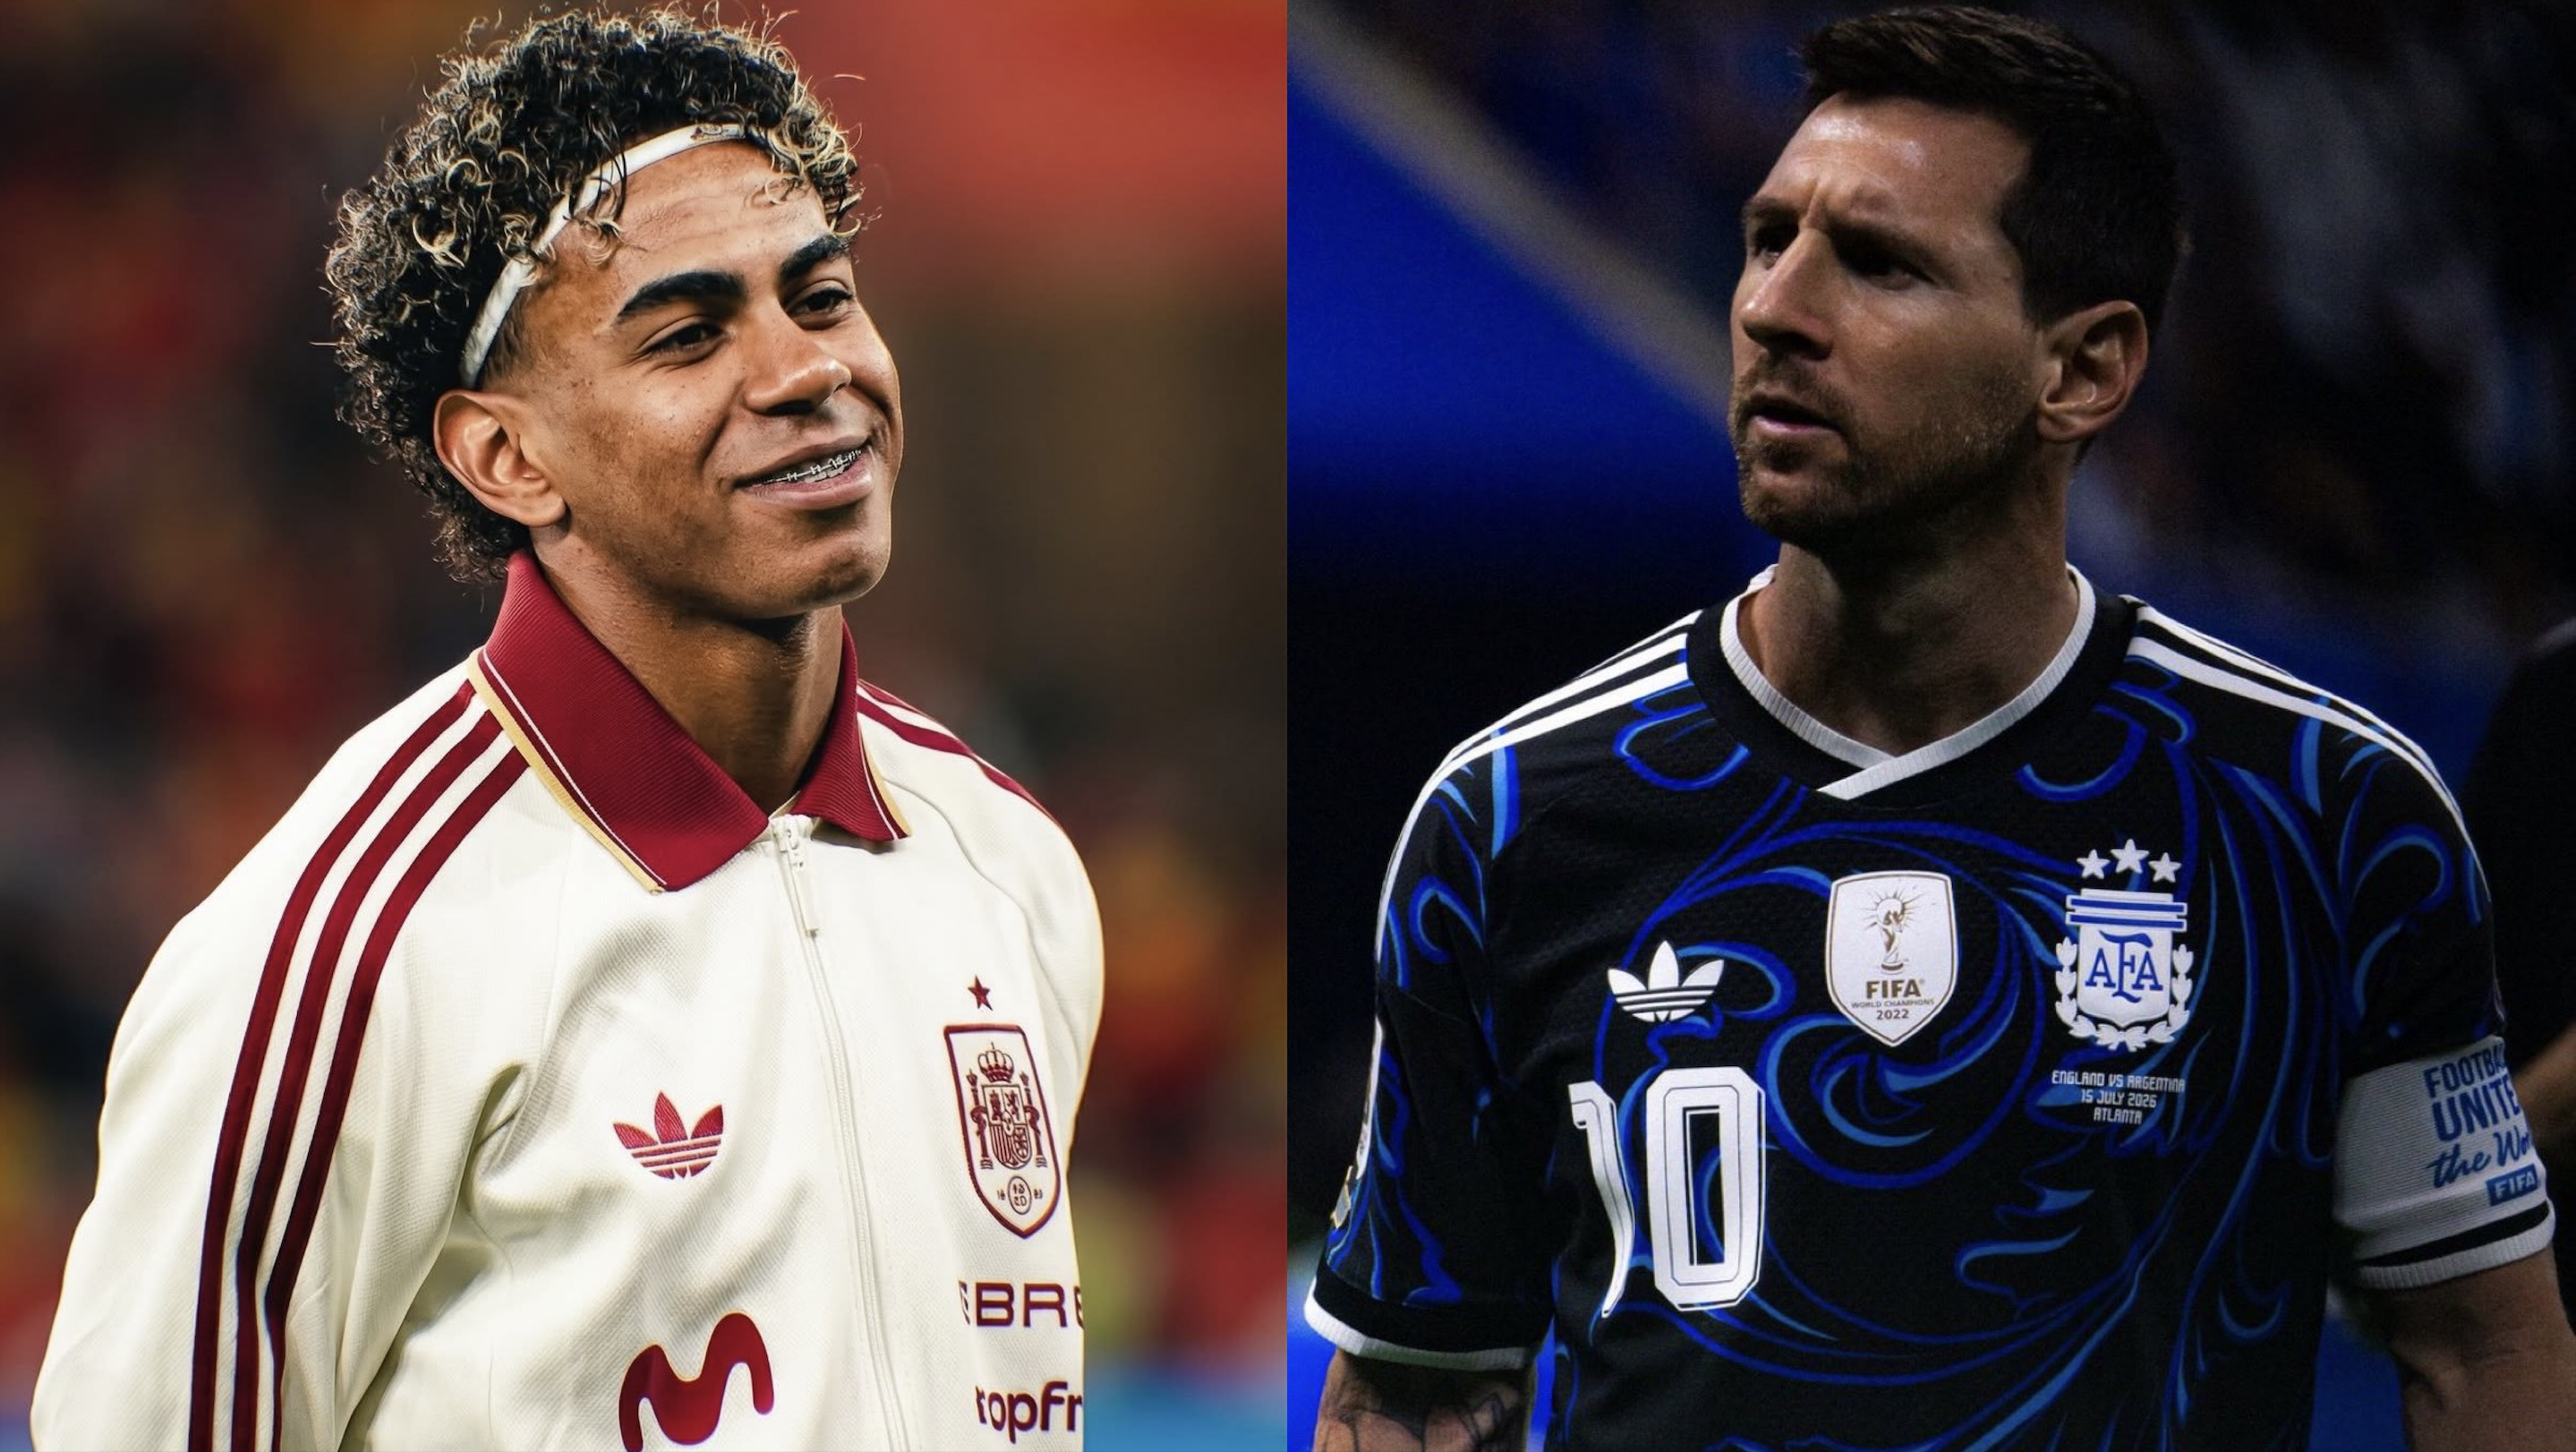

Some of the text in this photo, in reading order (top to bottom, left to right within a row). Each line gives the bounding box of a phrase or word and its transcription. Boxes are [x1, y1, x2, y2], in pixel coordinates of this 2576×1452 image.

[2085, 929, 2163, 1004] AFA
[1865, 978, 1922, 1000] FIFA
[1851, 998, 1935, 1009] WORLD CHAMPIONS
[1876, 1009, 1909, 1021] 2022
[2051, 1070, 2186, 1093] ENGLAND VS ARGENTINA
[2081, 1089, 2158, 1108] 15 JULY 2026
[2094, 1106, 2143, 1124] ATLANTA
[2427, 1144, 2491, 1188] the
[1568, 1066, 1766, 1318] 10
[2495, 1170, 2537, 1200] FIFA
